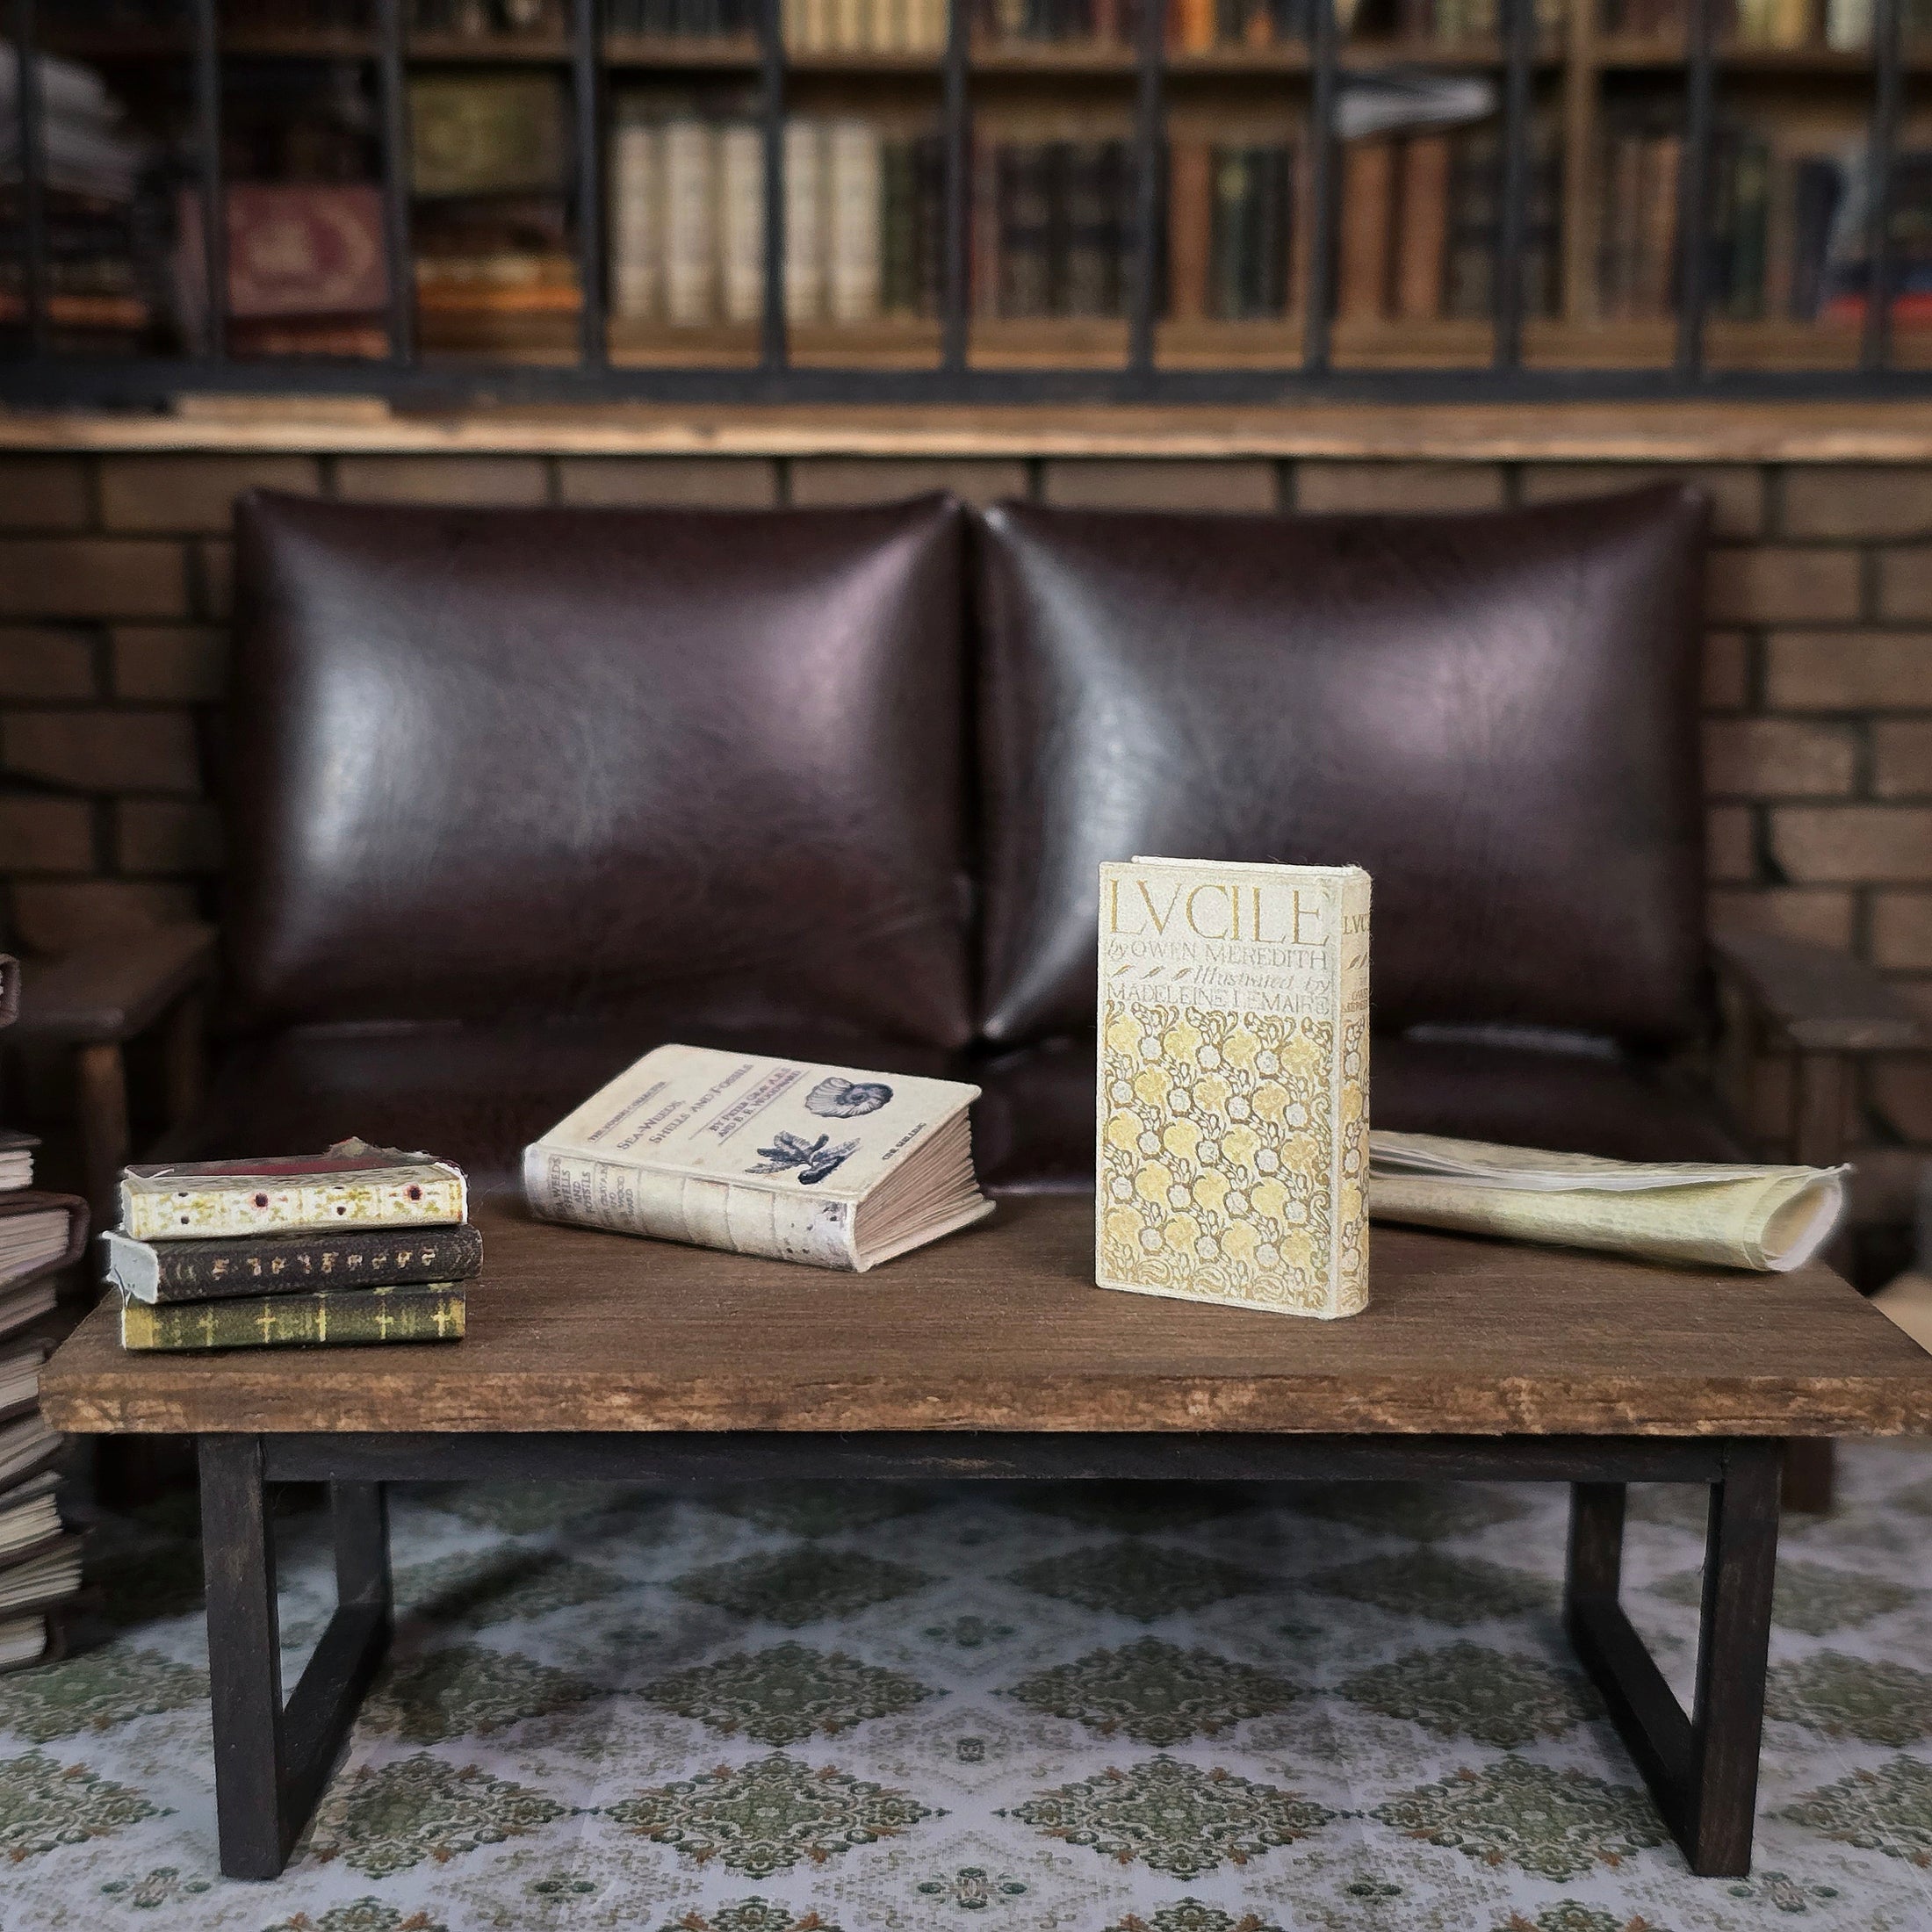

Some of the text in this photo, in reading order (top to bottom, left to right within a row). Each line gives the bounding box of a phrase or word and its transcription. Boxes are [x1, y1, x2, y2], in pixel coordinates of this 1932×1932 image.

[1110, 879, 1330, 947] LVCILE
[1131, 940, 1196, 960] OWEN
[1206, 942, 1328, 970] MEREDITH
[1107, 981, 1227, 1008] MADELEINE
[648, 1113, 690, 1144] SHELLS
[690, 1092, 714, 1113] AND
